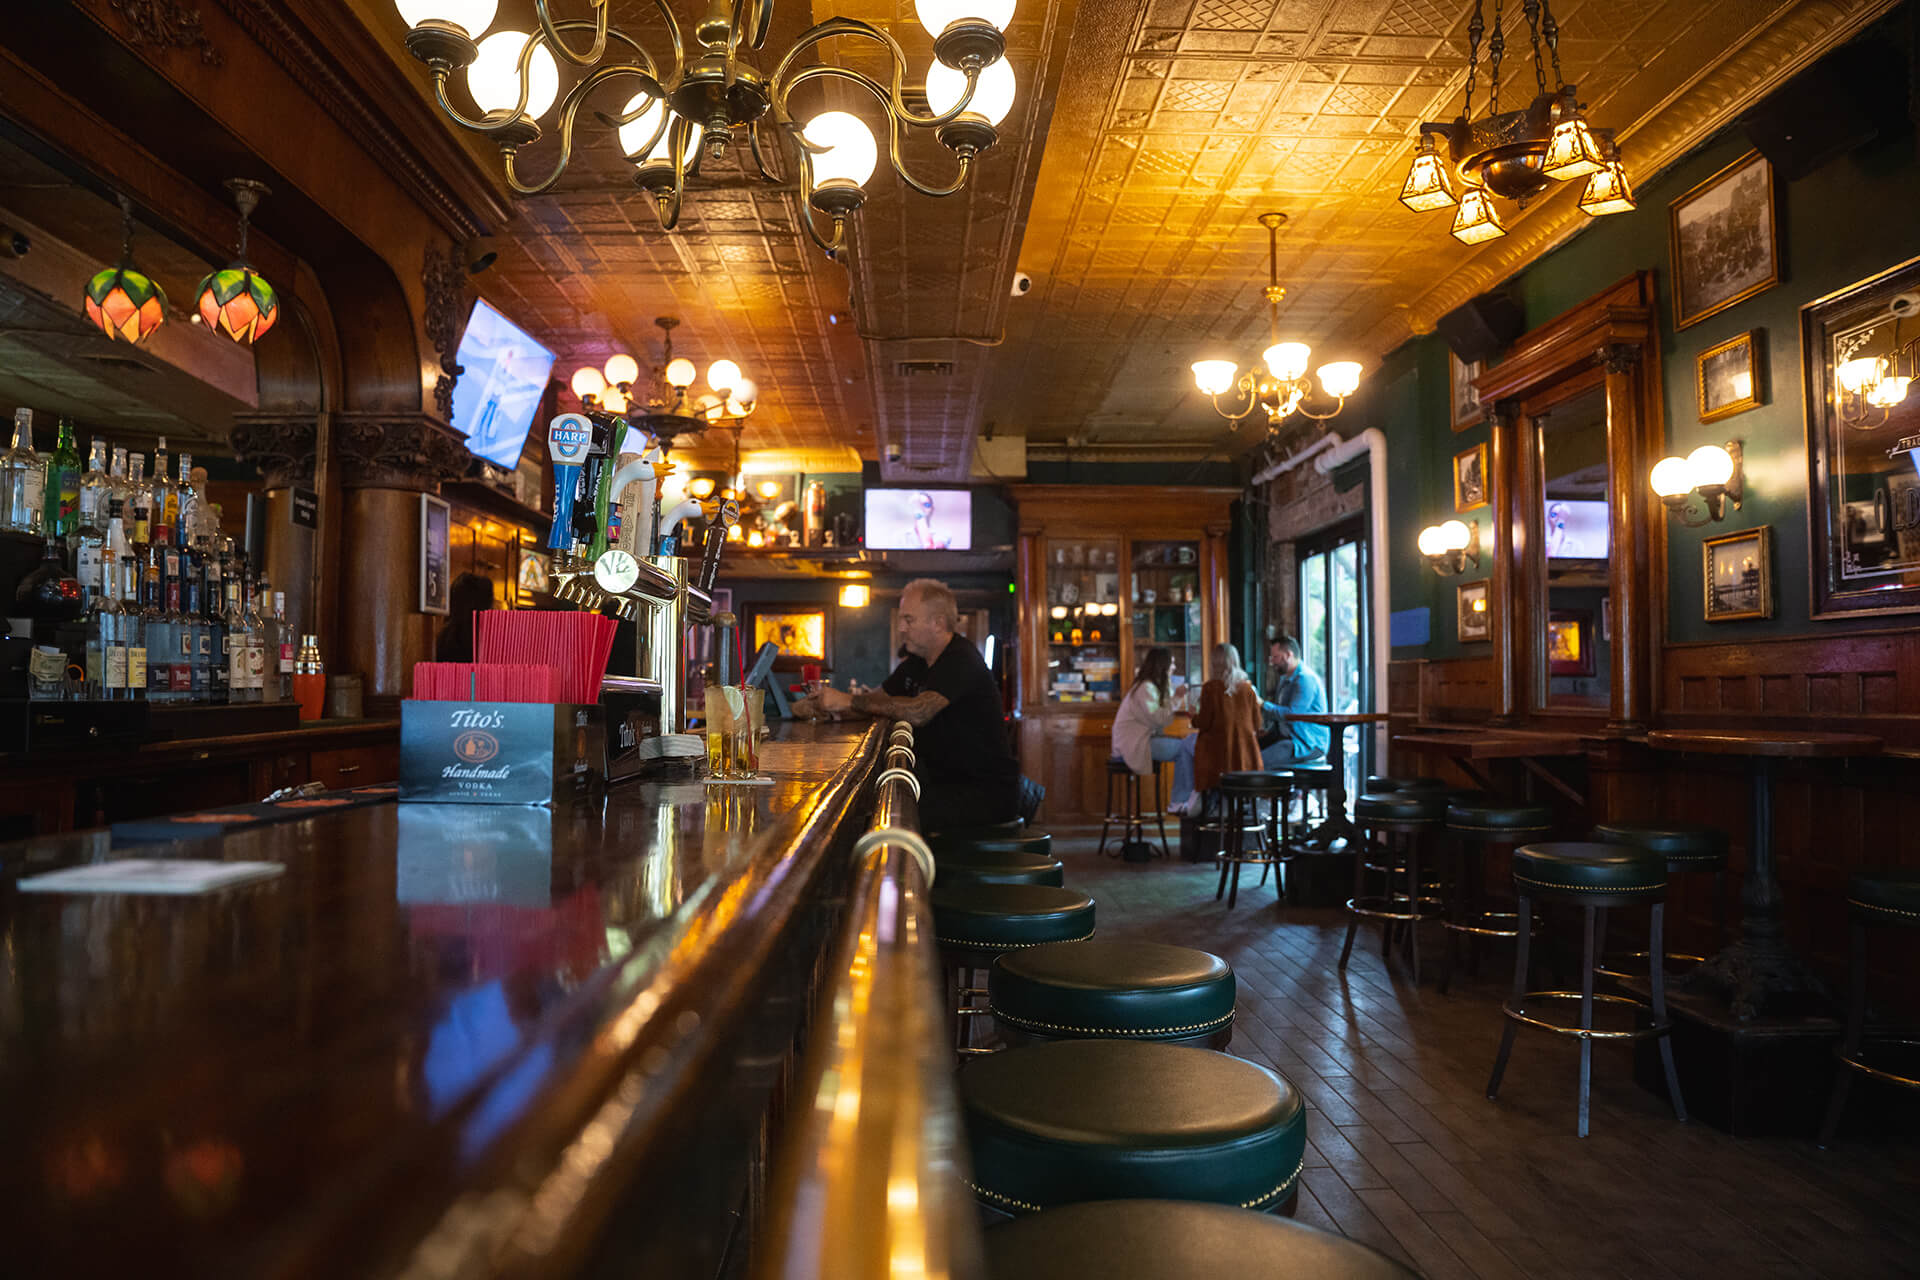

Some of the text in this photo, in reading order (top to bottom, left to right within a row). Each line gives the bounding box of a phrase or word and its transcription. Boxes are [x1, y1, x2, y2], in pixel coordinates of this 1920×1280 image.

[554, 430, 587, 443] HARP
[451, 709, 504, 728] Tito's
[441, 763, 511, 779] Handmade
[459, 782, 493, 790] VODKA
